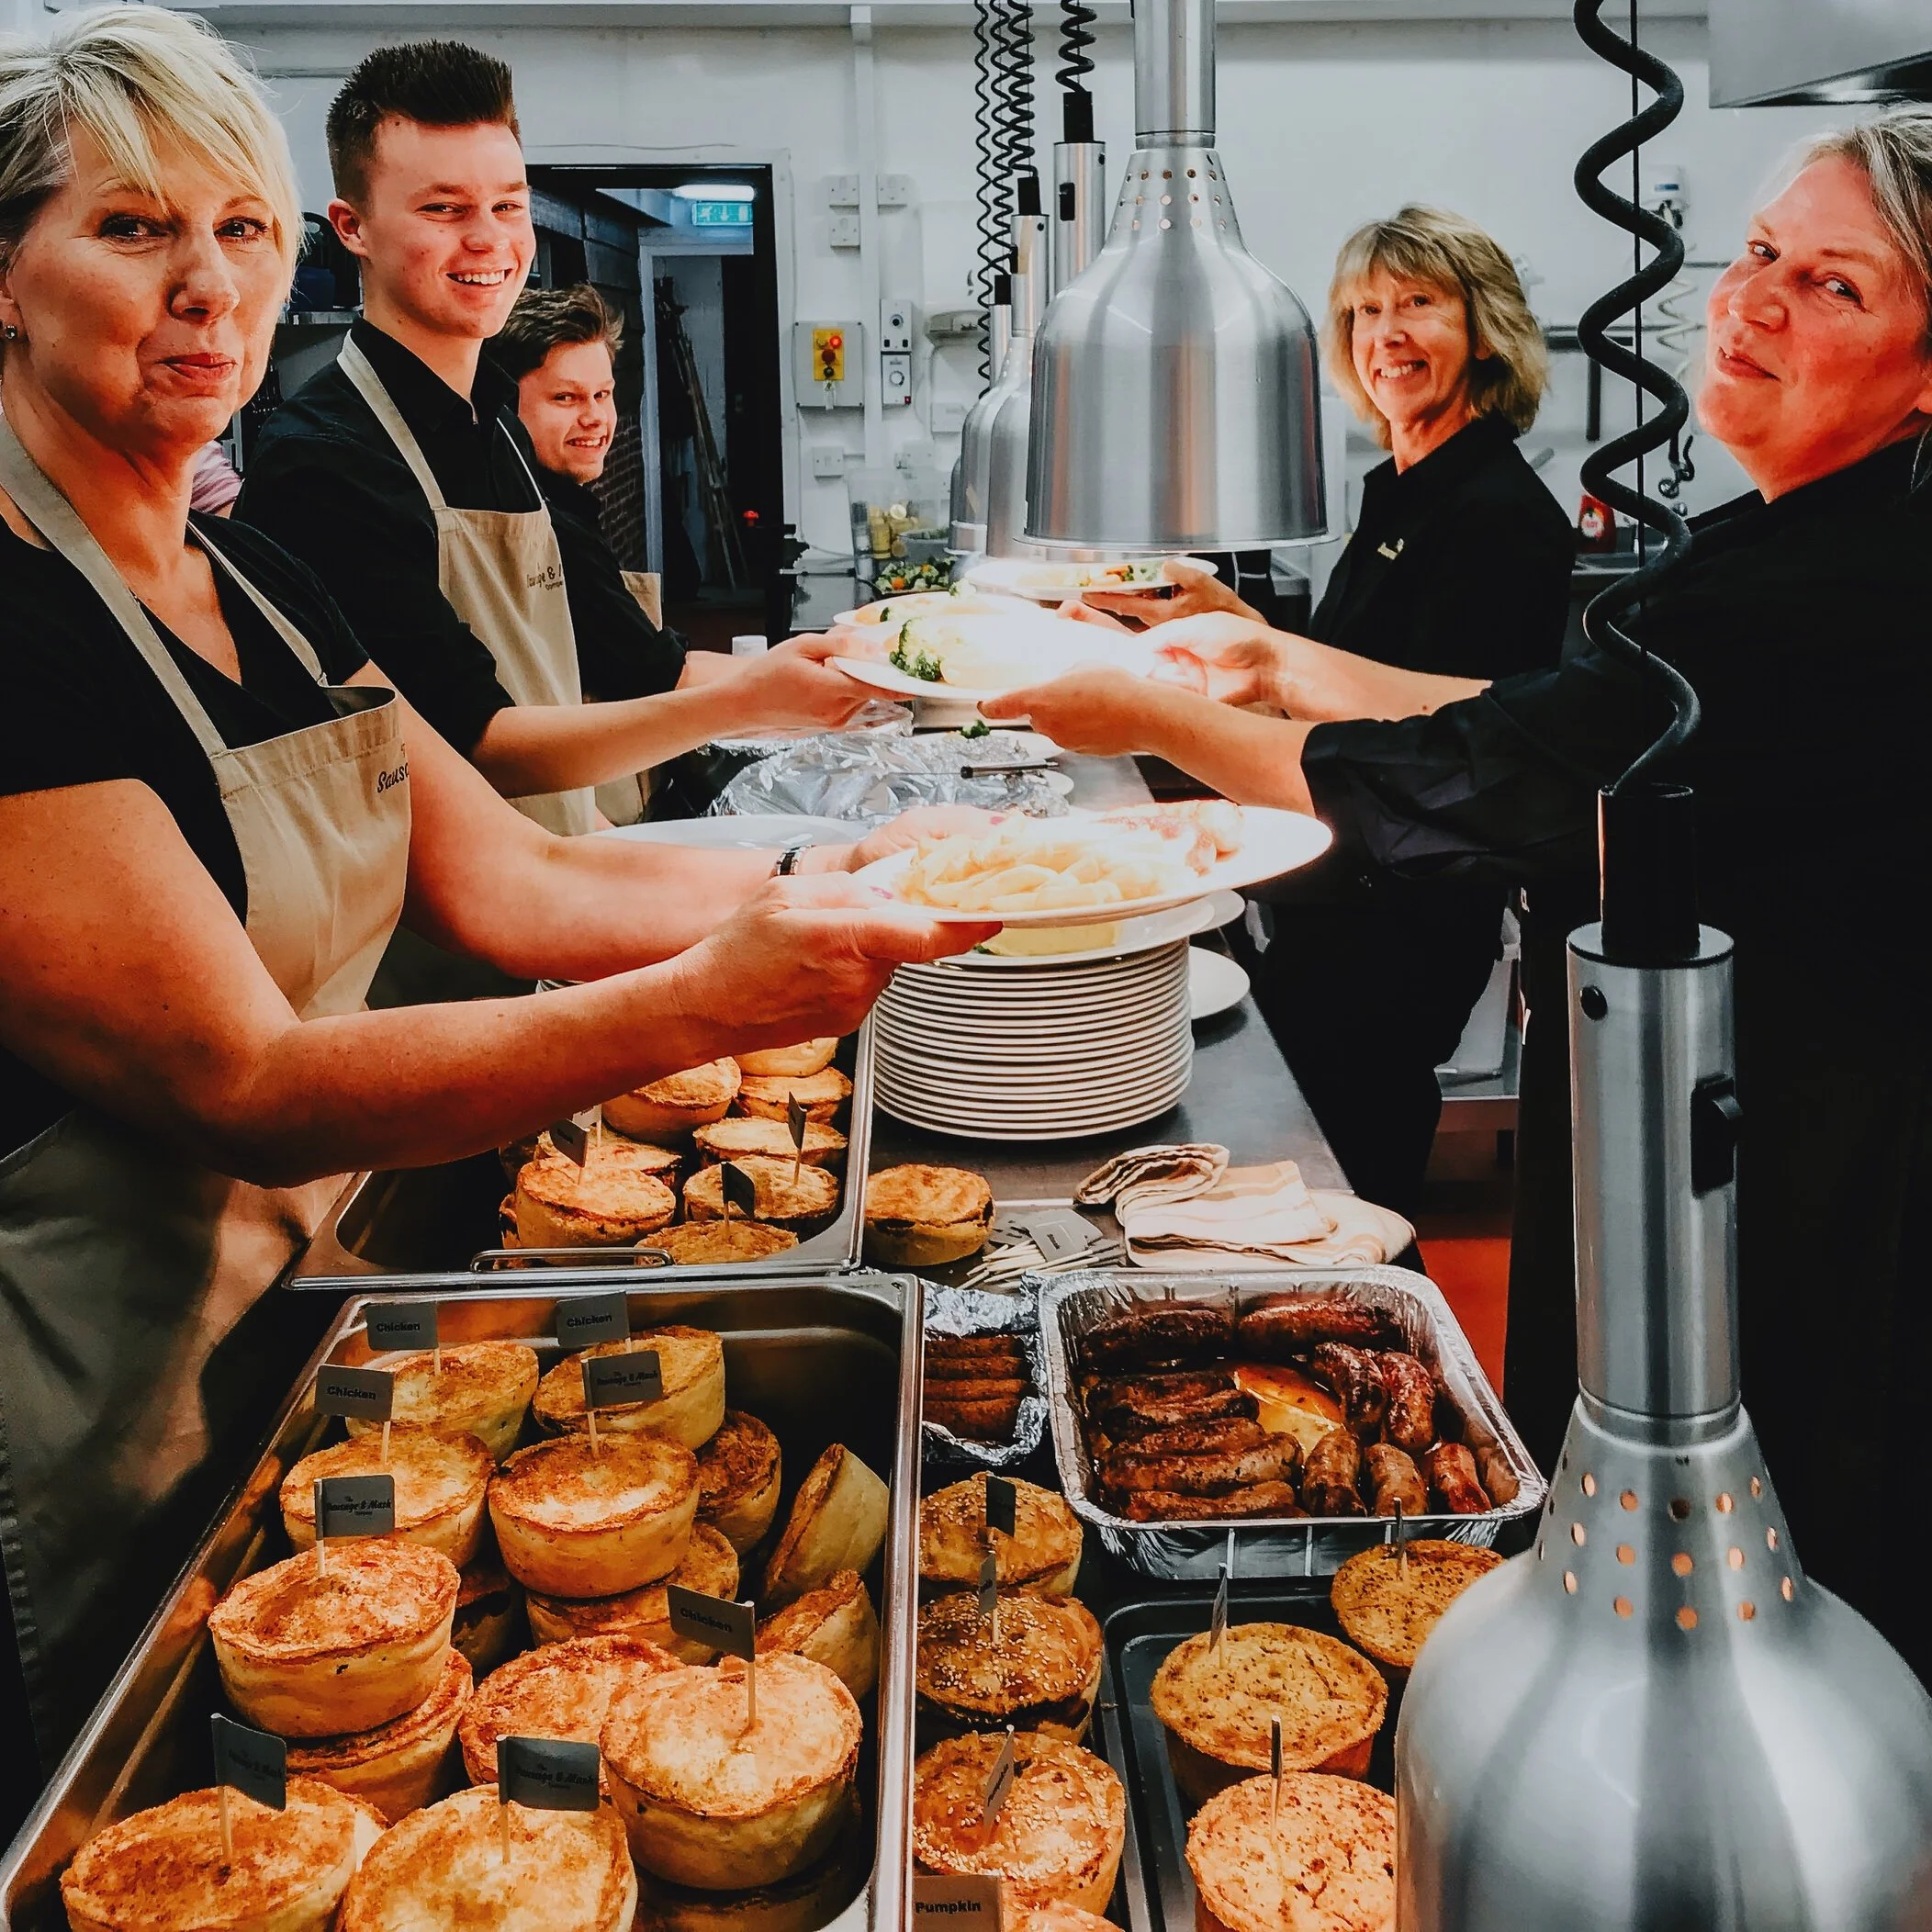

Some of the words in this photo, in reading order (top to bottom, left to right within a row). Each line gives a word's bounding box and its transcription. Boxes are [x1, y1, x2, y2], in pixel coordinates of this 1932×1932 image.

[547, 566, 556, 579] &
[376, 1321, 421, 1332] Chicken
[566, 1313, 612, 1328] Chicken
[326, 1387, 376, 1399] Chicken
[367, 1499, 392, 1510] Mash
[680, 1607, 734, 1633] Chicken
[915, 1899, 981, 1914] Pumpkin
